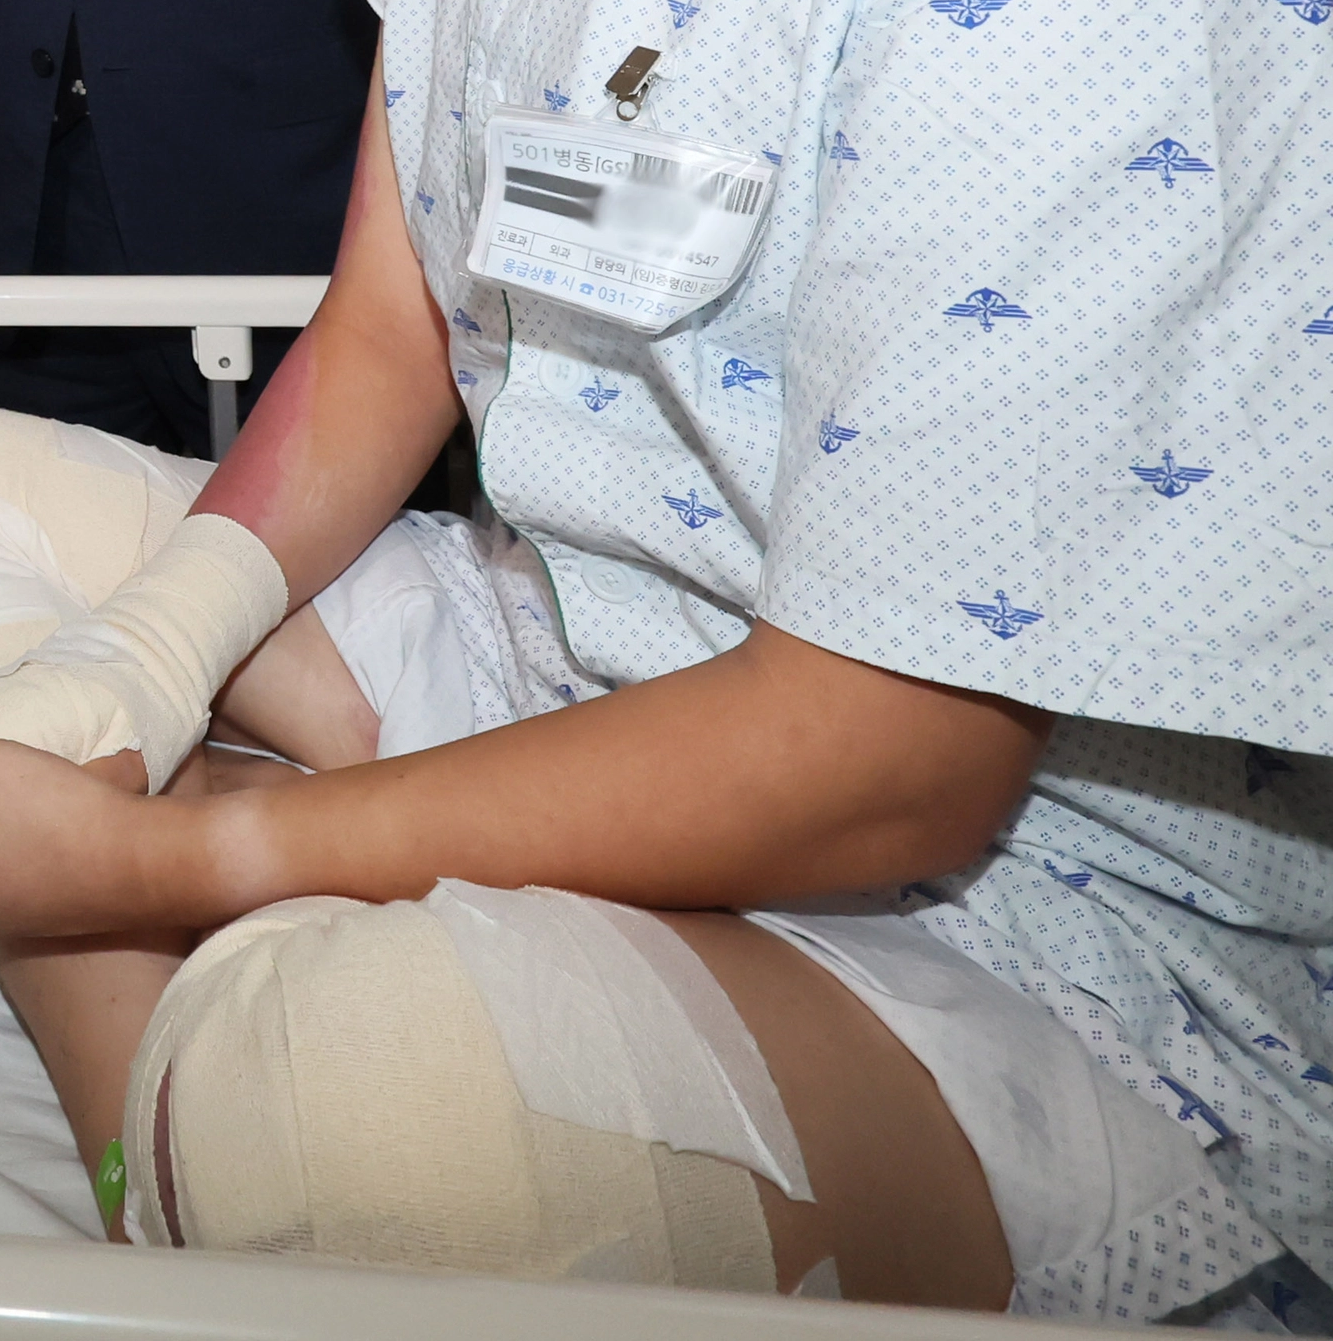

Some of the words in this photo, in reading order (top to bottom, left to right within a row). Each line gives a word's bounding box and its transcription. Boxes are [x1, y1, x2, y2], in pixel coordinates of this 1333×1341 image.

[497, 229, 528, 247] 진료과
[549, 243, 571, 259] 외과
[593, 256, 626, 275] 담당의
[502, 258, 557, 286] 응급상황
[561, 275, 576, 291] 시
[598, 286, 683, 318] 031-725-6
